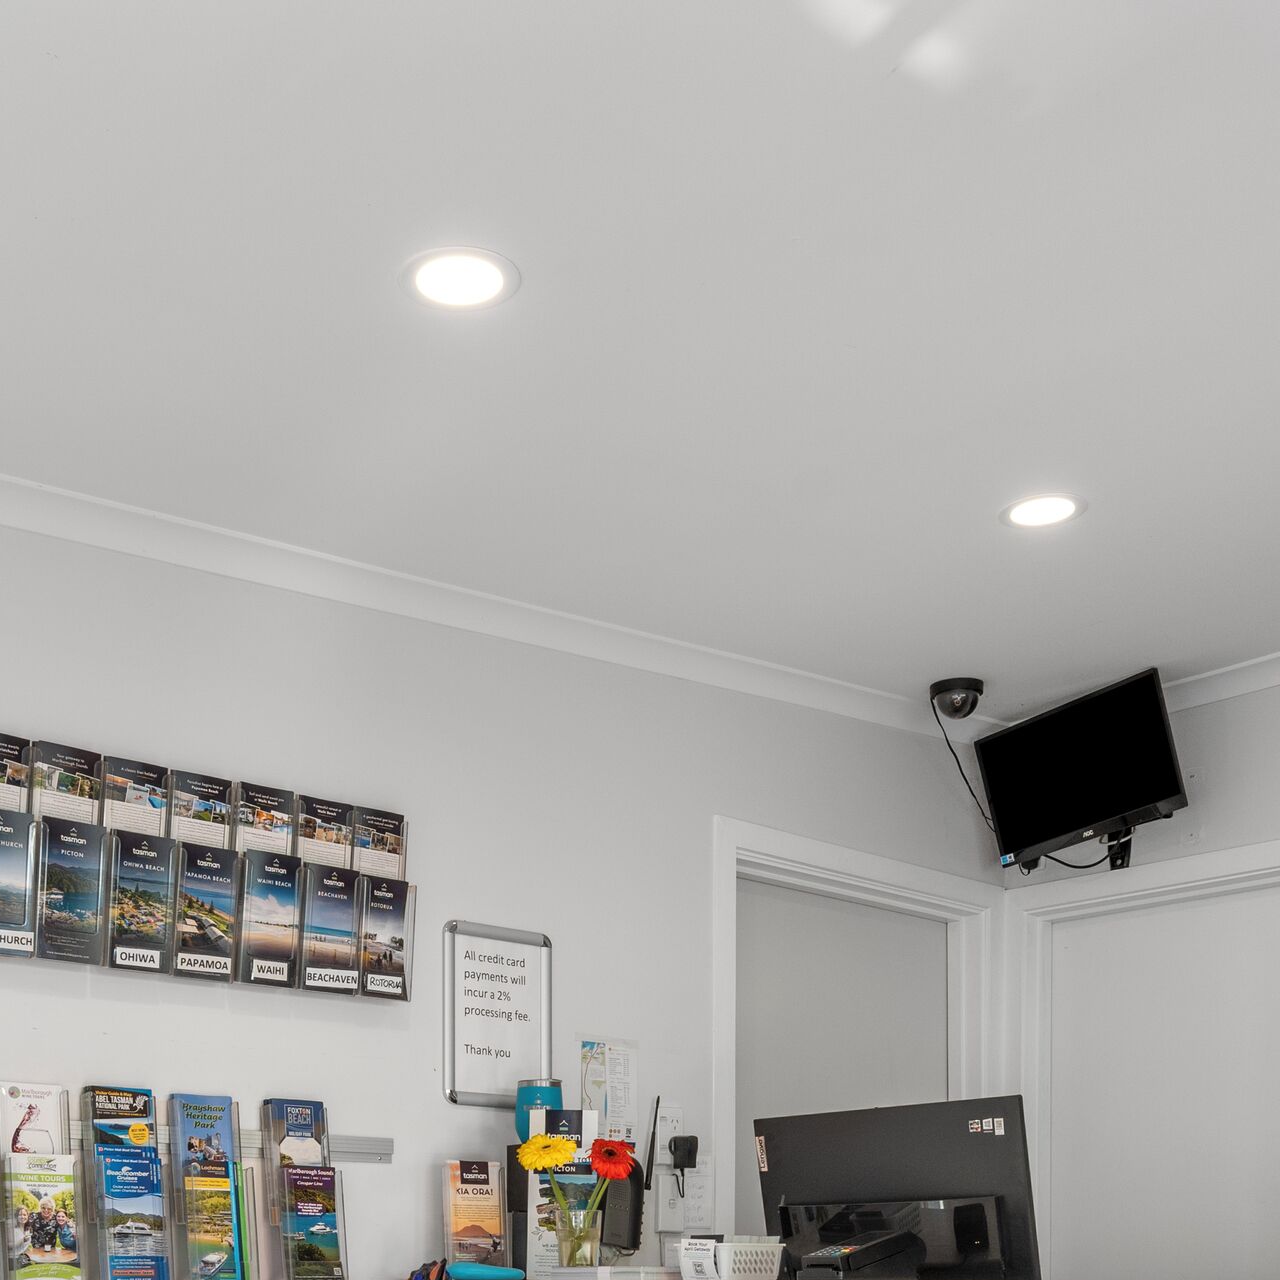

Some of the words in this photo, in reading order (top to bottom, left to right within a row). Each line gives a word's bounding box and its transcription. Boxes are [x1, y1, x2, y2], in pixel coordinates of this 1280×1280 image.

[60, 834, 87, 846] tasman
[61, 849, 84, 858] PICTON
[133, 848, 157, 858] tasman
[123, 861, 144, 869] OHIWA
[146, 864, 165, 872] BEACH
[197, 859, 220, 869] tasman
[265, 865, 287, 875] tasman
[185, 872, 211, 881] PAPAMOA
[213, 875, 231, 883] BEACH
[257, 878, 274, 886] WAIHI
[275, 880, 291, 888] BEACH
[324, 878, 344, 888] tasman
[318, 891, 347, 900] BEACHAVEN
[374, 889, 393, 898] tasman
[371, 902, 393, 910] ROTORUA
[120, 951, 155, 964] OHIWA
[464, 950, 476, 961] All
[478, 952, 505, 966] credit
[506, 958, 525, 968] card
[180, 957, 228, 971] PAPAMOA
[257, 964, 284, 975] WAIHI
[307, 972, 358, 984] BEACHAVEN
[464, 969, 508, 984] payments
[510, 976, 526, 986] will
[370, 977, 402, 989] ROTORUA
[464, 987, 487, 999] incur
[490, 992, 495, 1000] a
[497, 991, 511, 1001] 2%
[464, 1006, 513, 1022] processing
[514, 1010, 530, 1022] fee.
[464, 1044, 492, 1056] Thank
[494, 1048, 511, 1059] you
[96, 1095, 109, 1103] ABEL
[110, 1095, 133, 1104] TASMAN
[183, 1103, 225, 1112] Brayshaw
[288, 1106, 310, 1115] FOXTON
[186, 1112, 223, 1122] Heritage
[288, 1114, 311, 1124] BEACH
[758, 1138, 766, 1170] Lenovo
[472, 1188, 493, 1196] ORA!
